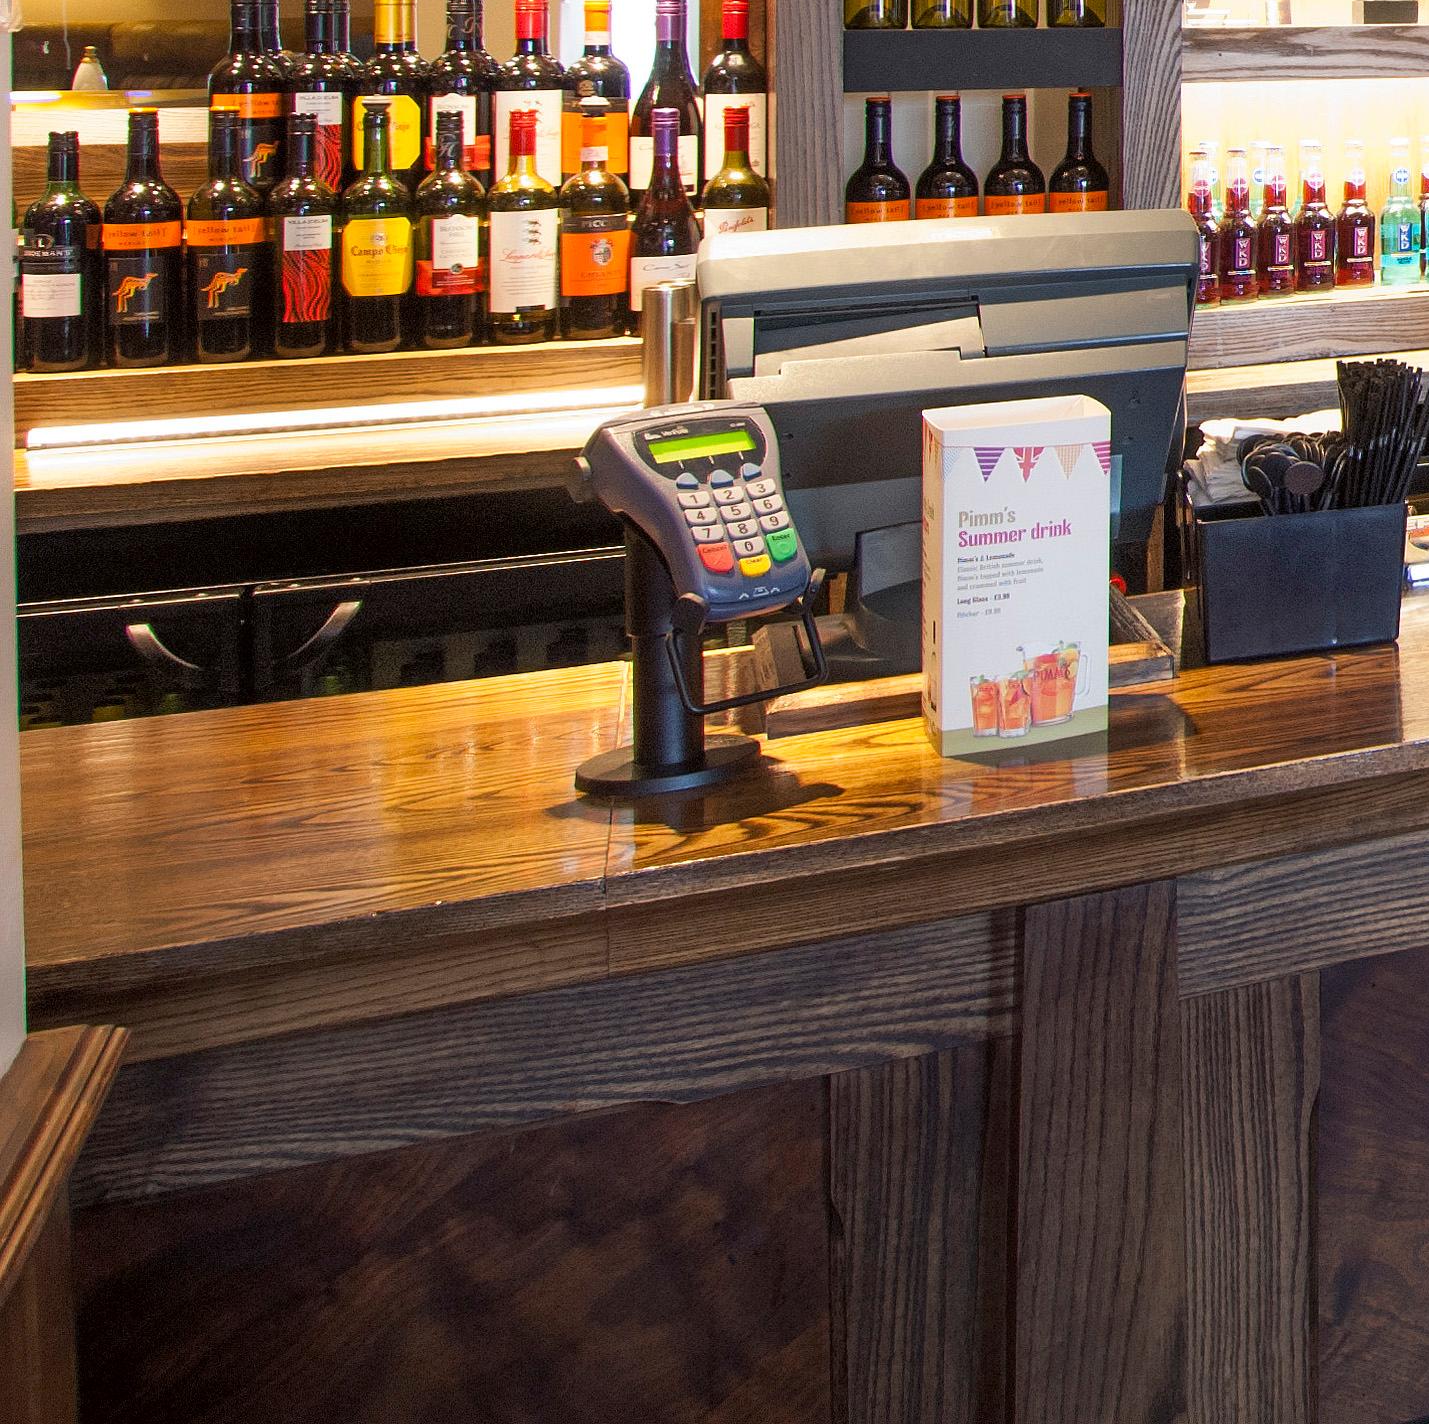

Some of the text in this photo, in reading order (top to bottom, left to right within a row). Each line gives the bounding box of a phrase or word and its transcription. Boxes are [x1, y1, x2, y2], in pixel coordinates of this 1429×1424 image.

[1313, 233, 1324, 258] WKD
[1357, 229, 1369, 255] WKD
[1399, 223, 1411, 250] WKD
[1238, 240, 1249, 267] WKD
[689, 483, 766, 504] 1 2 3
[696, 499, 772, 521] 4 5 6
[958, 506, 1016, 529] Pimm's
[703, 516, 779, 538] 7 8 9
[958, 518, 1073, 548] Summer drink
[744, 541, 754, 552] 0
